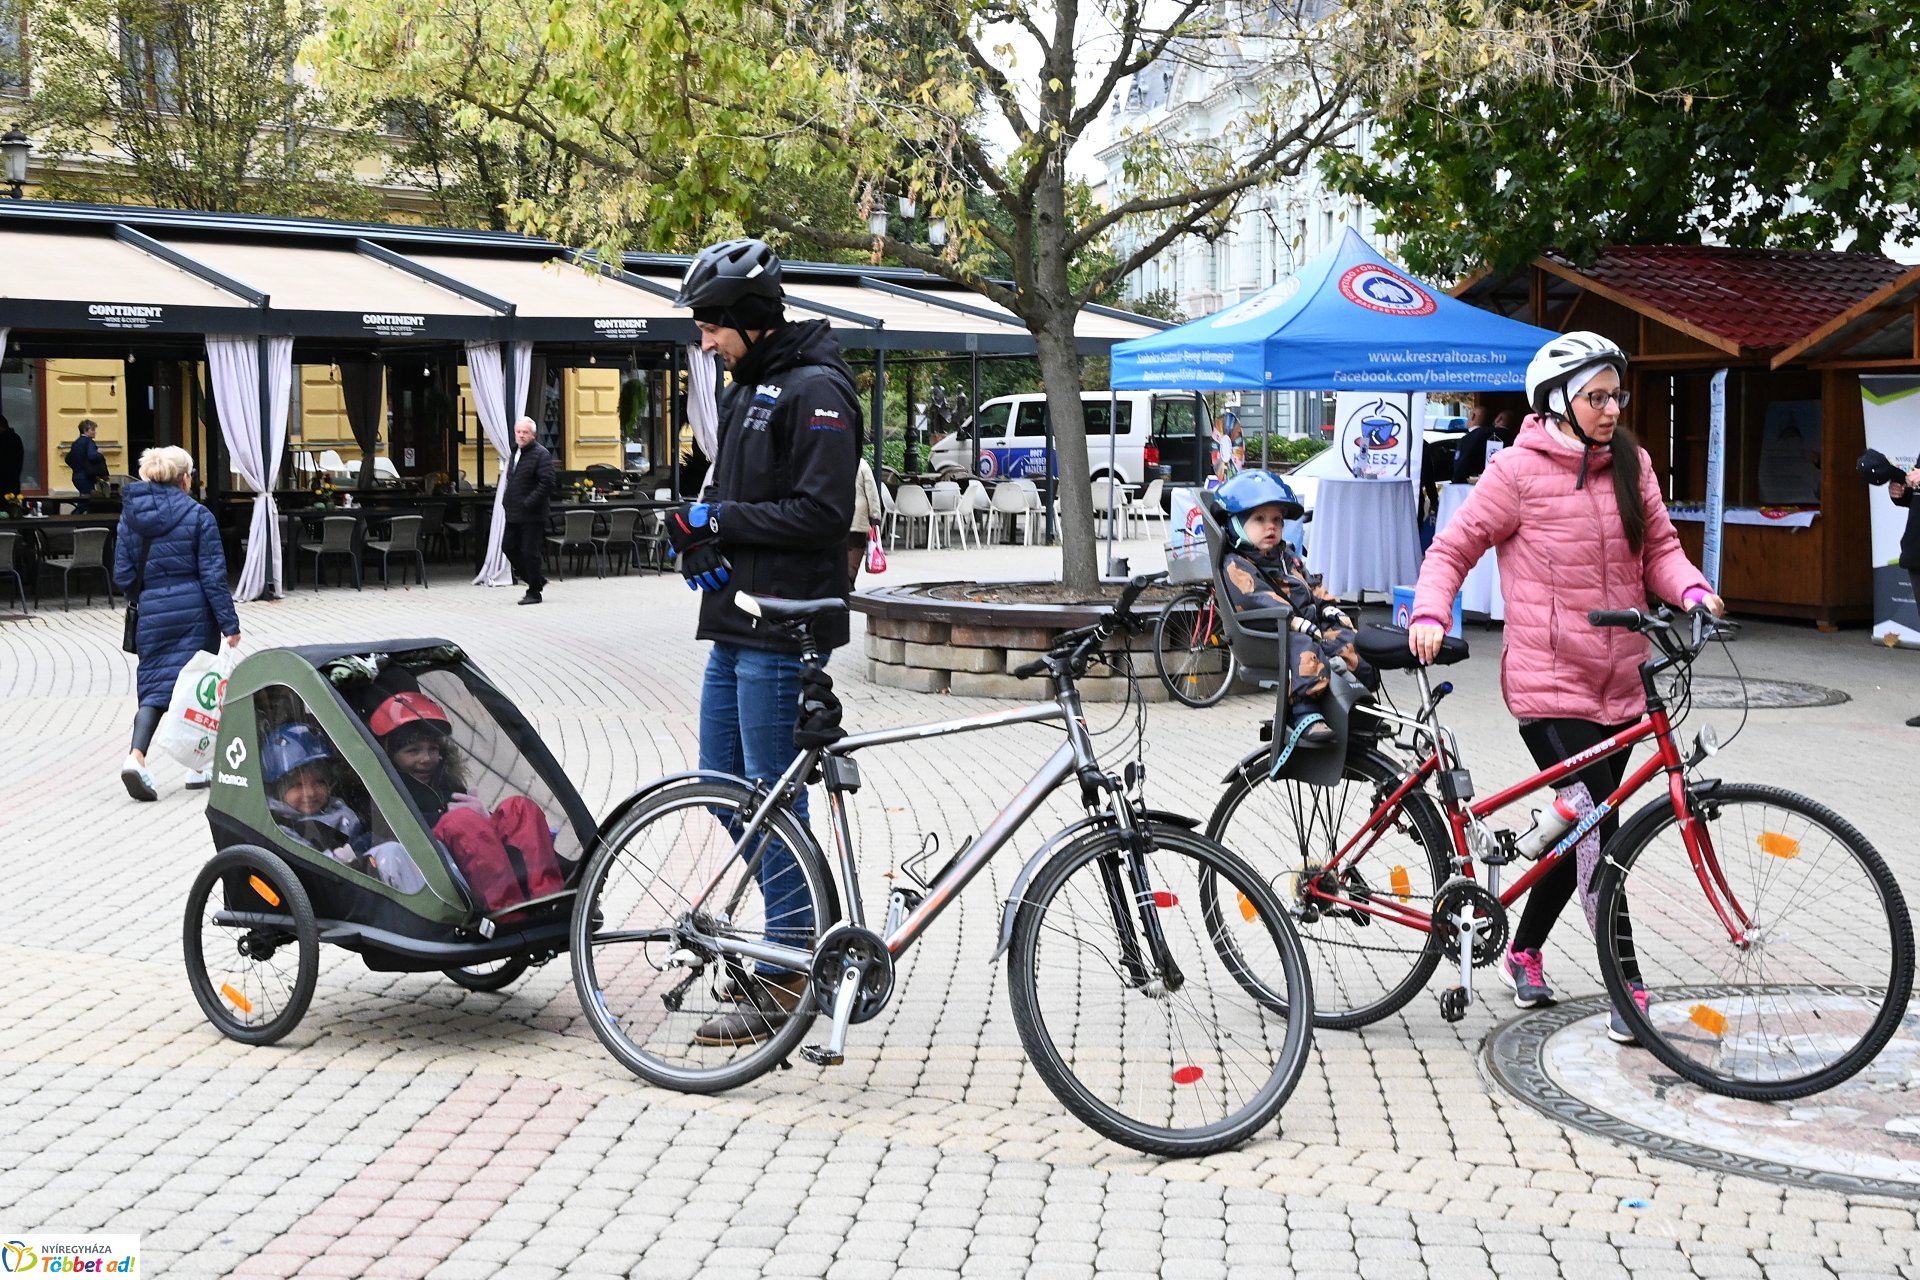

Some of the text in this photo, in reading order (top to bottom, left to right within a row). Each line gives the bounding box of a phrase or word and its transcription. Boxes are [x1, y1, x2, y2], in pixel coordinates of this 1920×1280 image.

[88, 304, 163, 317] CONTINENT
[363, 314, 425, 326] CONTINENT
[594, 319, 648, 329] CONTINENT
[1368, 350, 1507, 364] www.kreszvaltozas.hu
